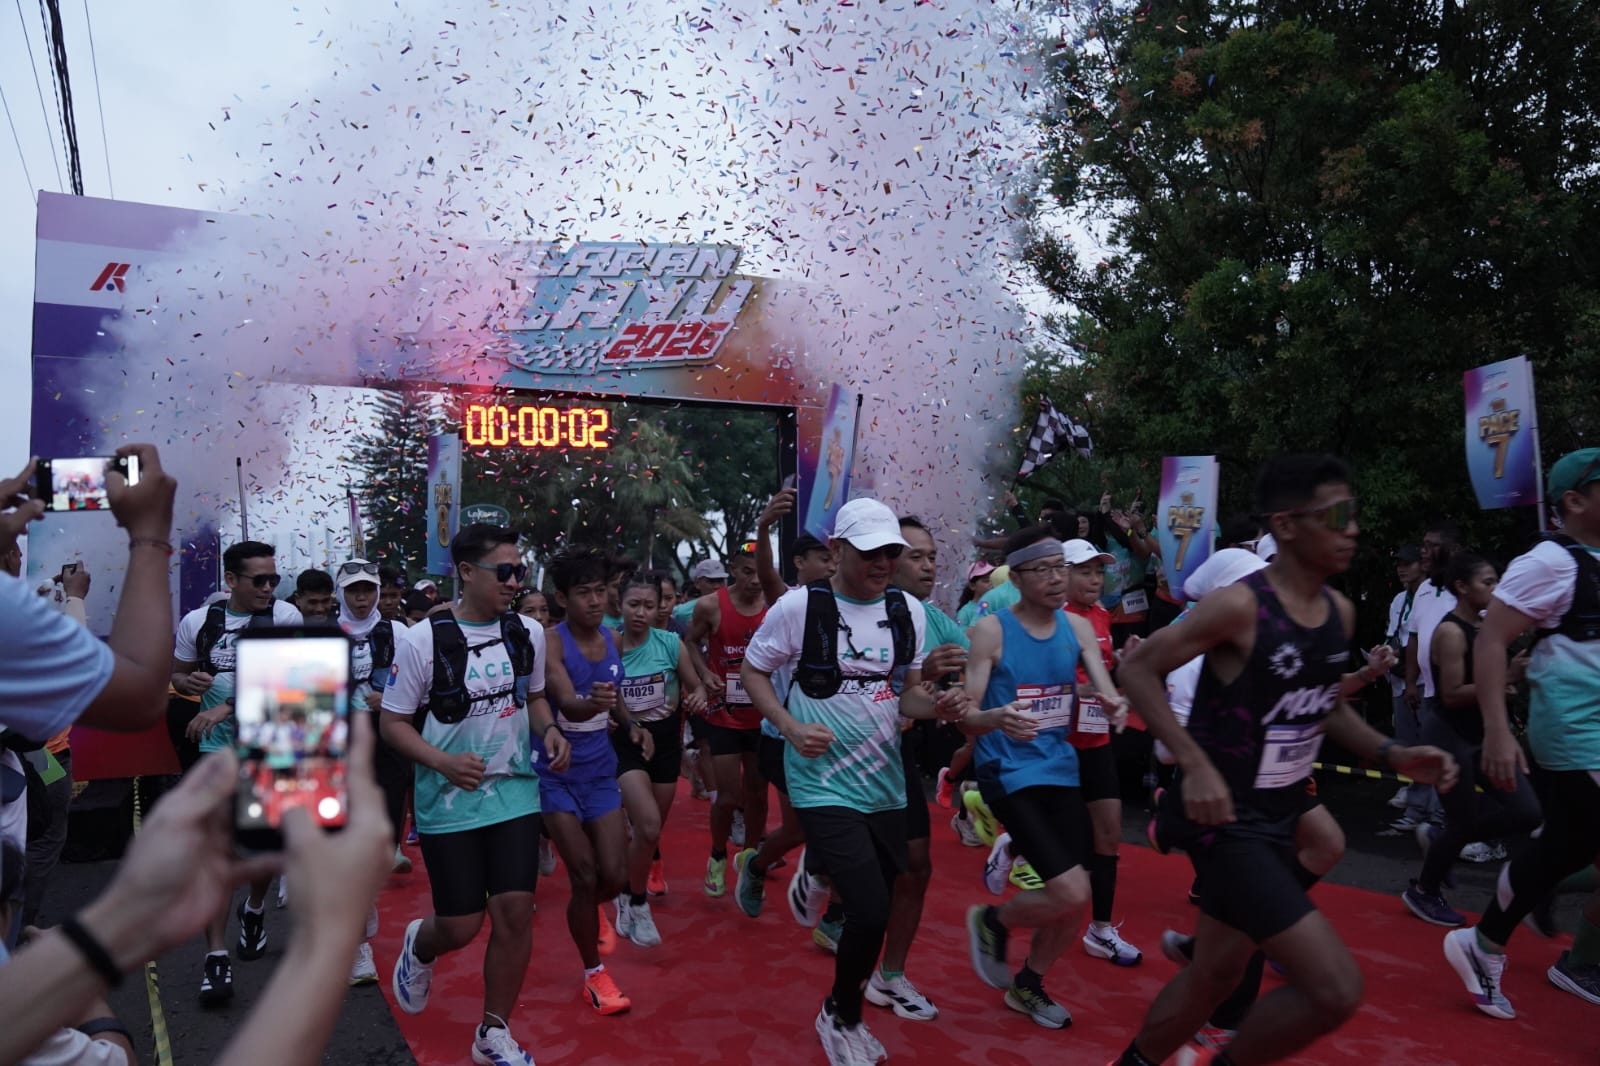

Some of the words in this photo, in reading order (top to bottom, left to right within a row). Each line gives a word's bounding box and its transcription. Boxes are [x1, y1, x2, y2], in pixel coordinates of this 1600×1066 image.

[604, 321, 731, 360] 2026
[465, 404, 609, 448] 00:00:02
[1479, 409, 1521, 438] PACE
[1486, 433, 1511, 479] 7
[1168, 506, 1205, 529] PACE
[1173, 527, 1194, 571] 7
[623, 685, 655, 698] F4029
